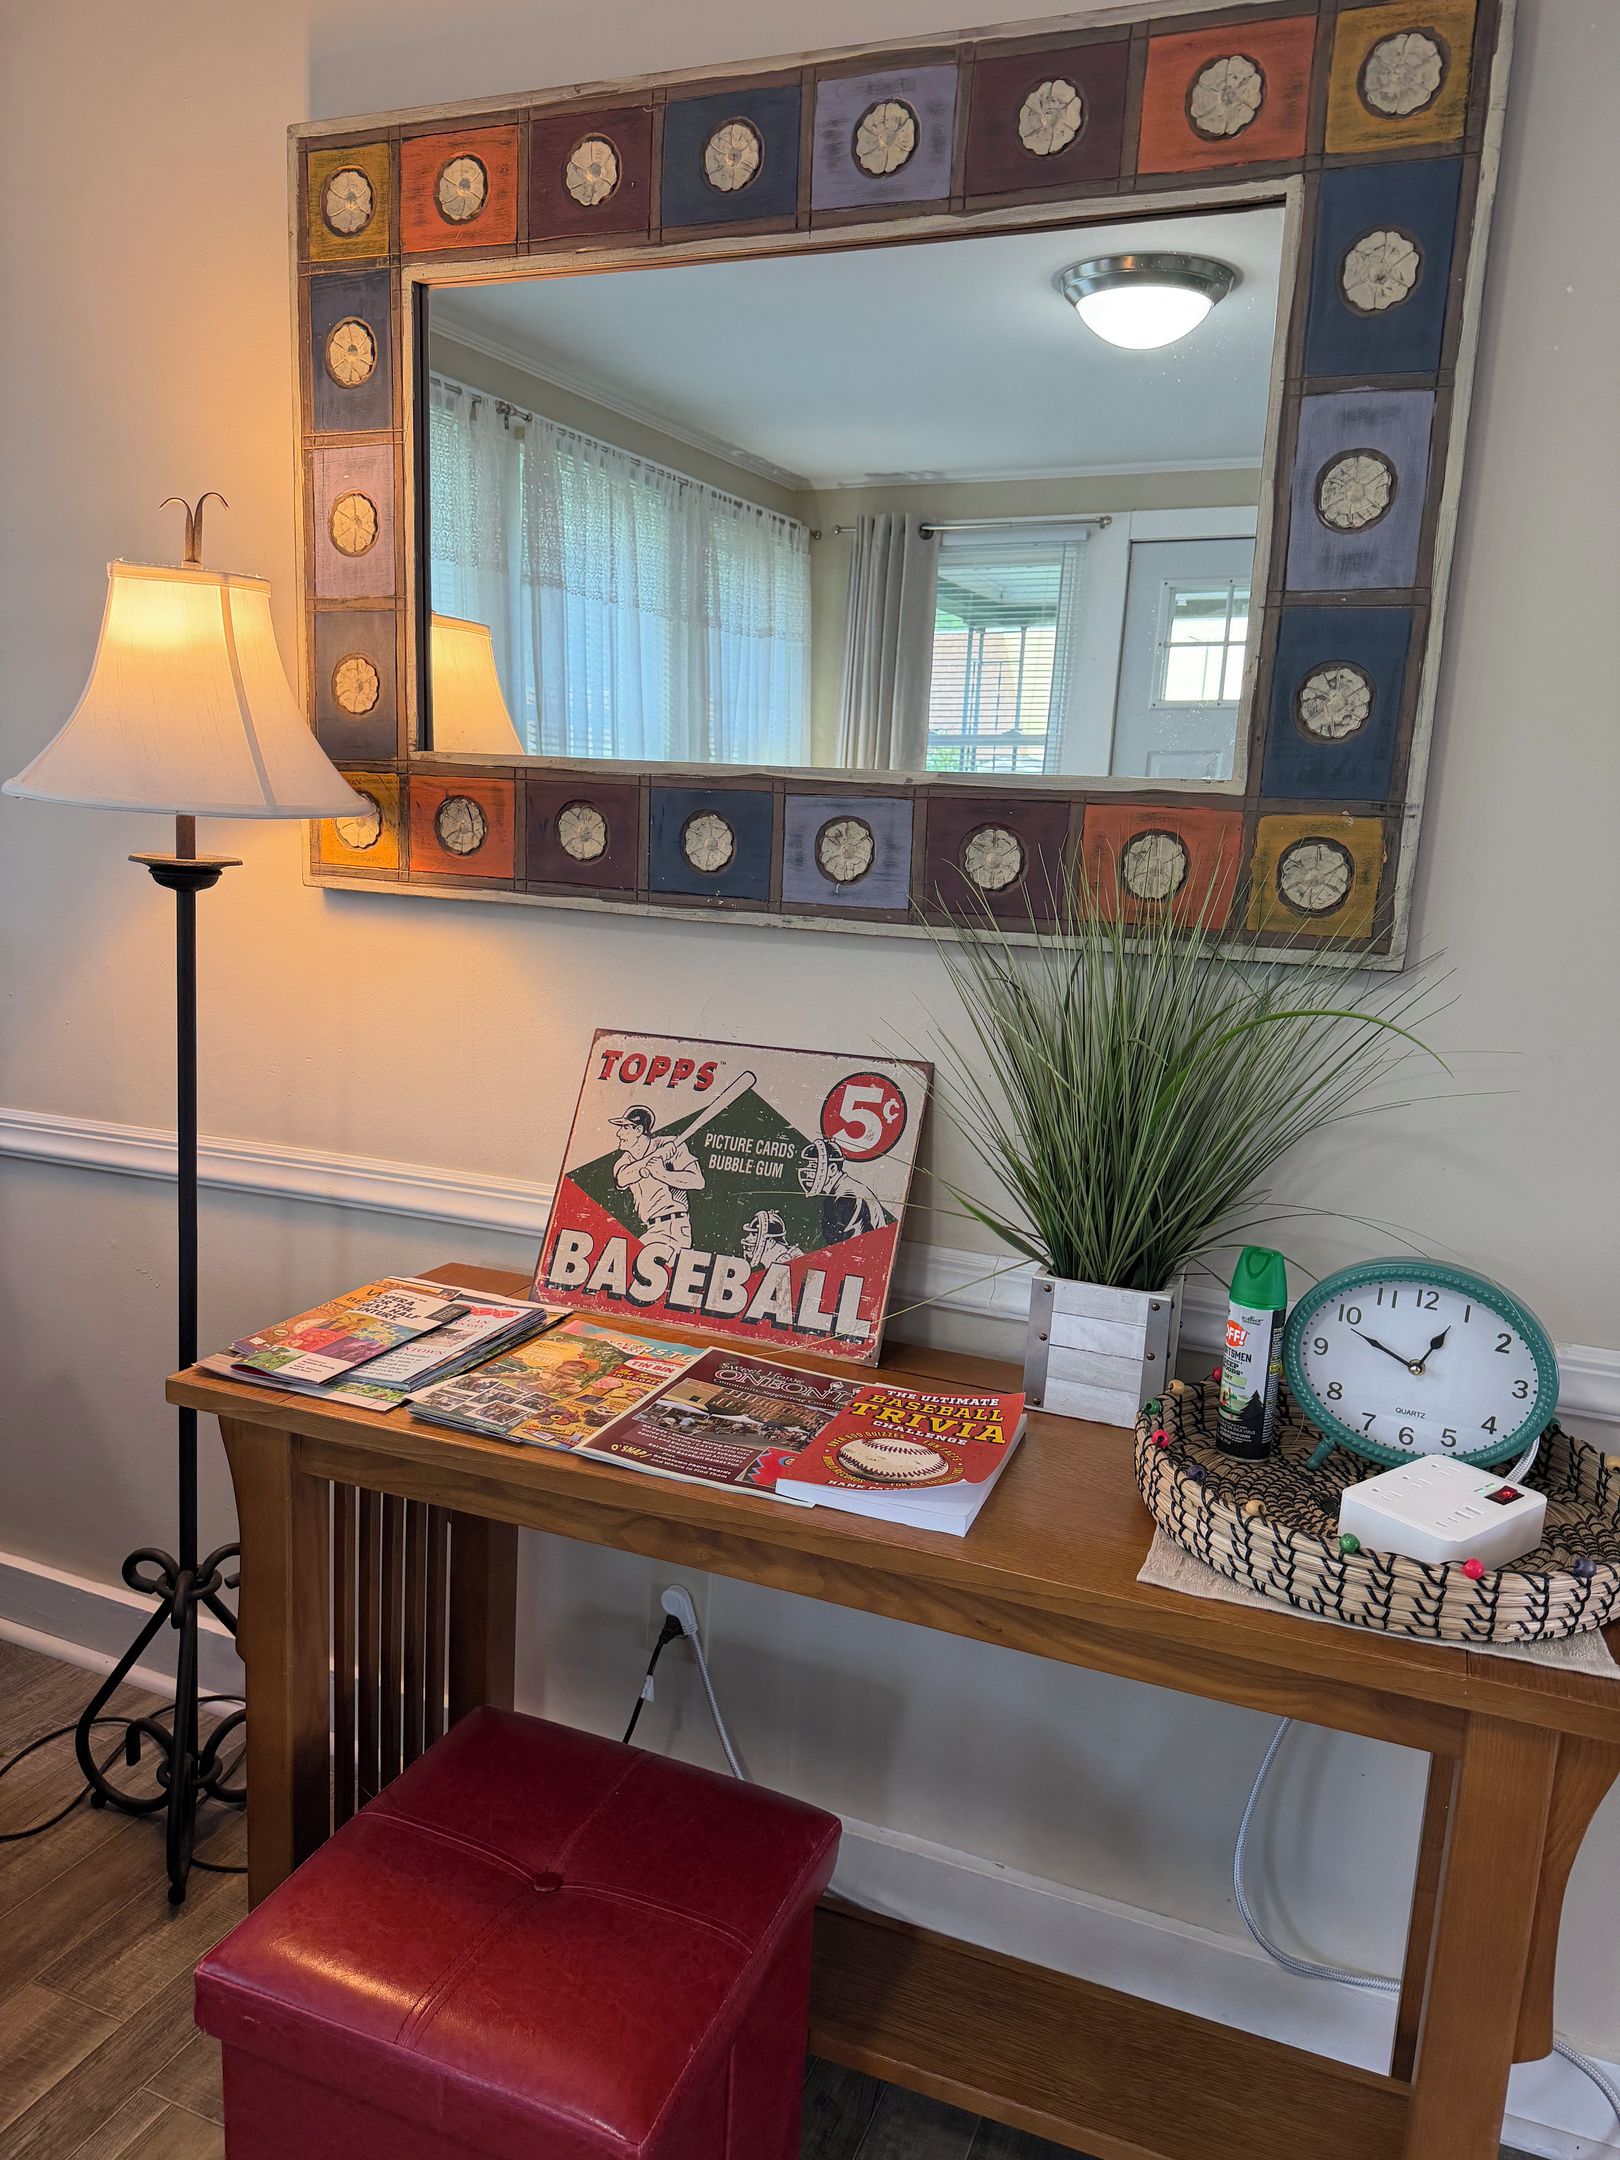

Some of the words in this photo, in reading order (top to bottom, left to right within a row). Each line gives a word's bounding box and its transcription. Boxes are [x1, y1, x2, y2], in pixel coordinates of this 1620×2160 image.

[597, 1048, 718, 1091] TOPPS
[705, 1133, 752, 1155] PICTURE
[755, 1140, 795, 1159] CARDS
[708, 1154, 754, 1174] BUBBLE
[755, 1161, 784, 1179] GUM
[545, 1229, 872, 1344] BASEBALL
[1377, 1288, 1397, 1308] 11
[1416, 1289, 1440, 1310] 12
[1338, 1304, 1362, 1325] 10
[1464, 1305, 1471, 1323] 1
[1313, 1337, 1329, 1355] 9
[1495, 1333, 1512, 1354] 2
[632, 1361, 652, 1369] TIN
[653, 1364, 676, 1373] BIN
[721, 1362, 762, 1377] Sweet
[765, 1371, 805, 1383] Home
[714, 1369, 850, 1402] ONEONT
[1326, 1381, 1343, 1400] 8
[1511, 1380, 1528, 1399] 3
[886, 1389, 916, 1400] THE
[921, 1395, 999, 1406] ULTIMATE
[869, 1394, 1004, 1422] BASEBALL
[1395, 1407, 1426, 1419] QUARTZ
[850, 1402, 1006, 1444] TRIVIA
[1362, 1412, 1376, 1431] 7
[1481, 1416, 1497, 1435] 4
[864, 1431, 906, 1440] QUIZZES
[872, 1420, 968, 1446] CHALLENGE
[1398, 1426, 1414, 1446] 6
[1440, 1428, 1457, 1447] 5
[672, 1432, 702, 1443] Complete
[703, 1440, 723, 1448] Dining
[723, 1444, 754, 1454] Directory
[922, 1440, 941, 1449] FUN
[653, 1454, 688, 1466] Downtown
[676, 1451, 705, 1460] Baseball
[716, 1451, 747, 1460] Schedule
[827, 1480, 866, 1489] HANK
